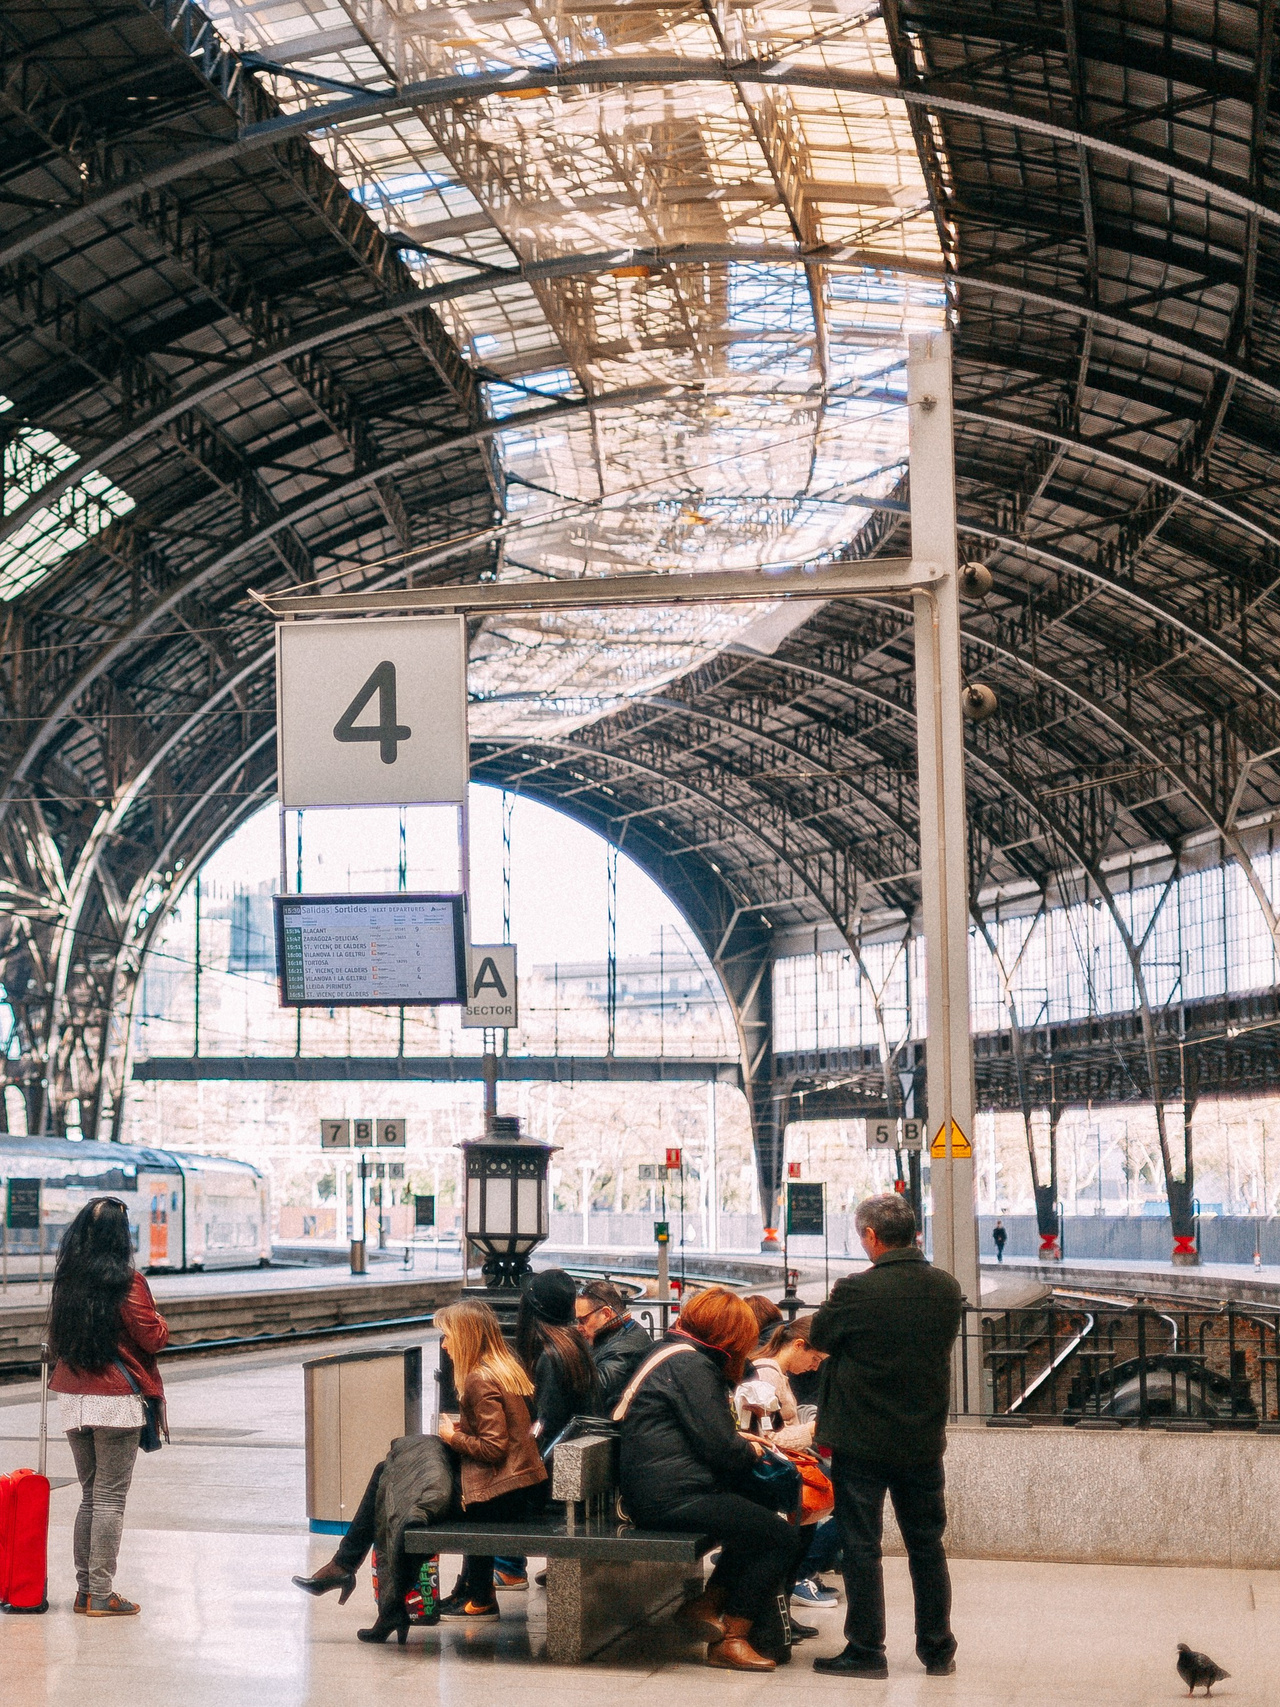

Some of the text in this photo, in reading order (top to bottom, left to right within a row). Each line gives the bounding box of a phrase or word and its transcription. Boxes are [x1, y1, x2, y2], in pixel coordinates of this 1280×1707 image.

[333, 660, 412, 764] 4
[302, 906, 330, 914] Salidas
[334, 905, 368, 913] Sortides
[474, 957, 507, 998] A
[466, 1005, 512, 1015] SECTOR
[330, 1123, 397, 1142] 7 B 6
[876, 1124, 919, 1143] 5 B
